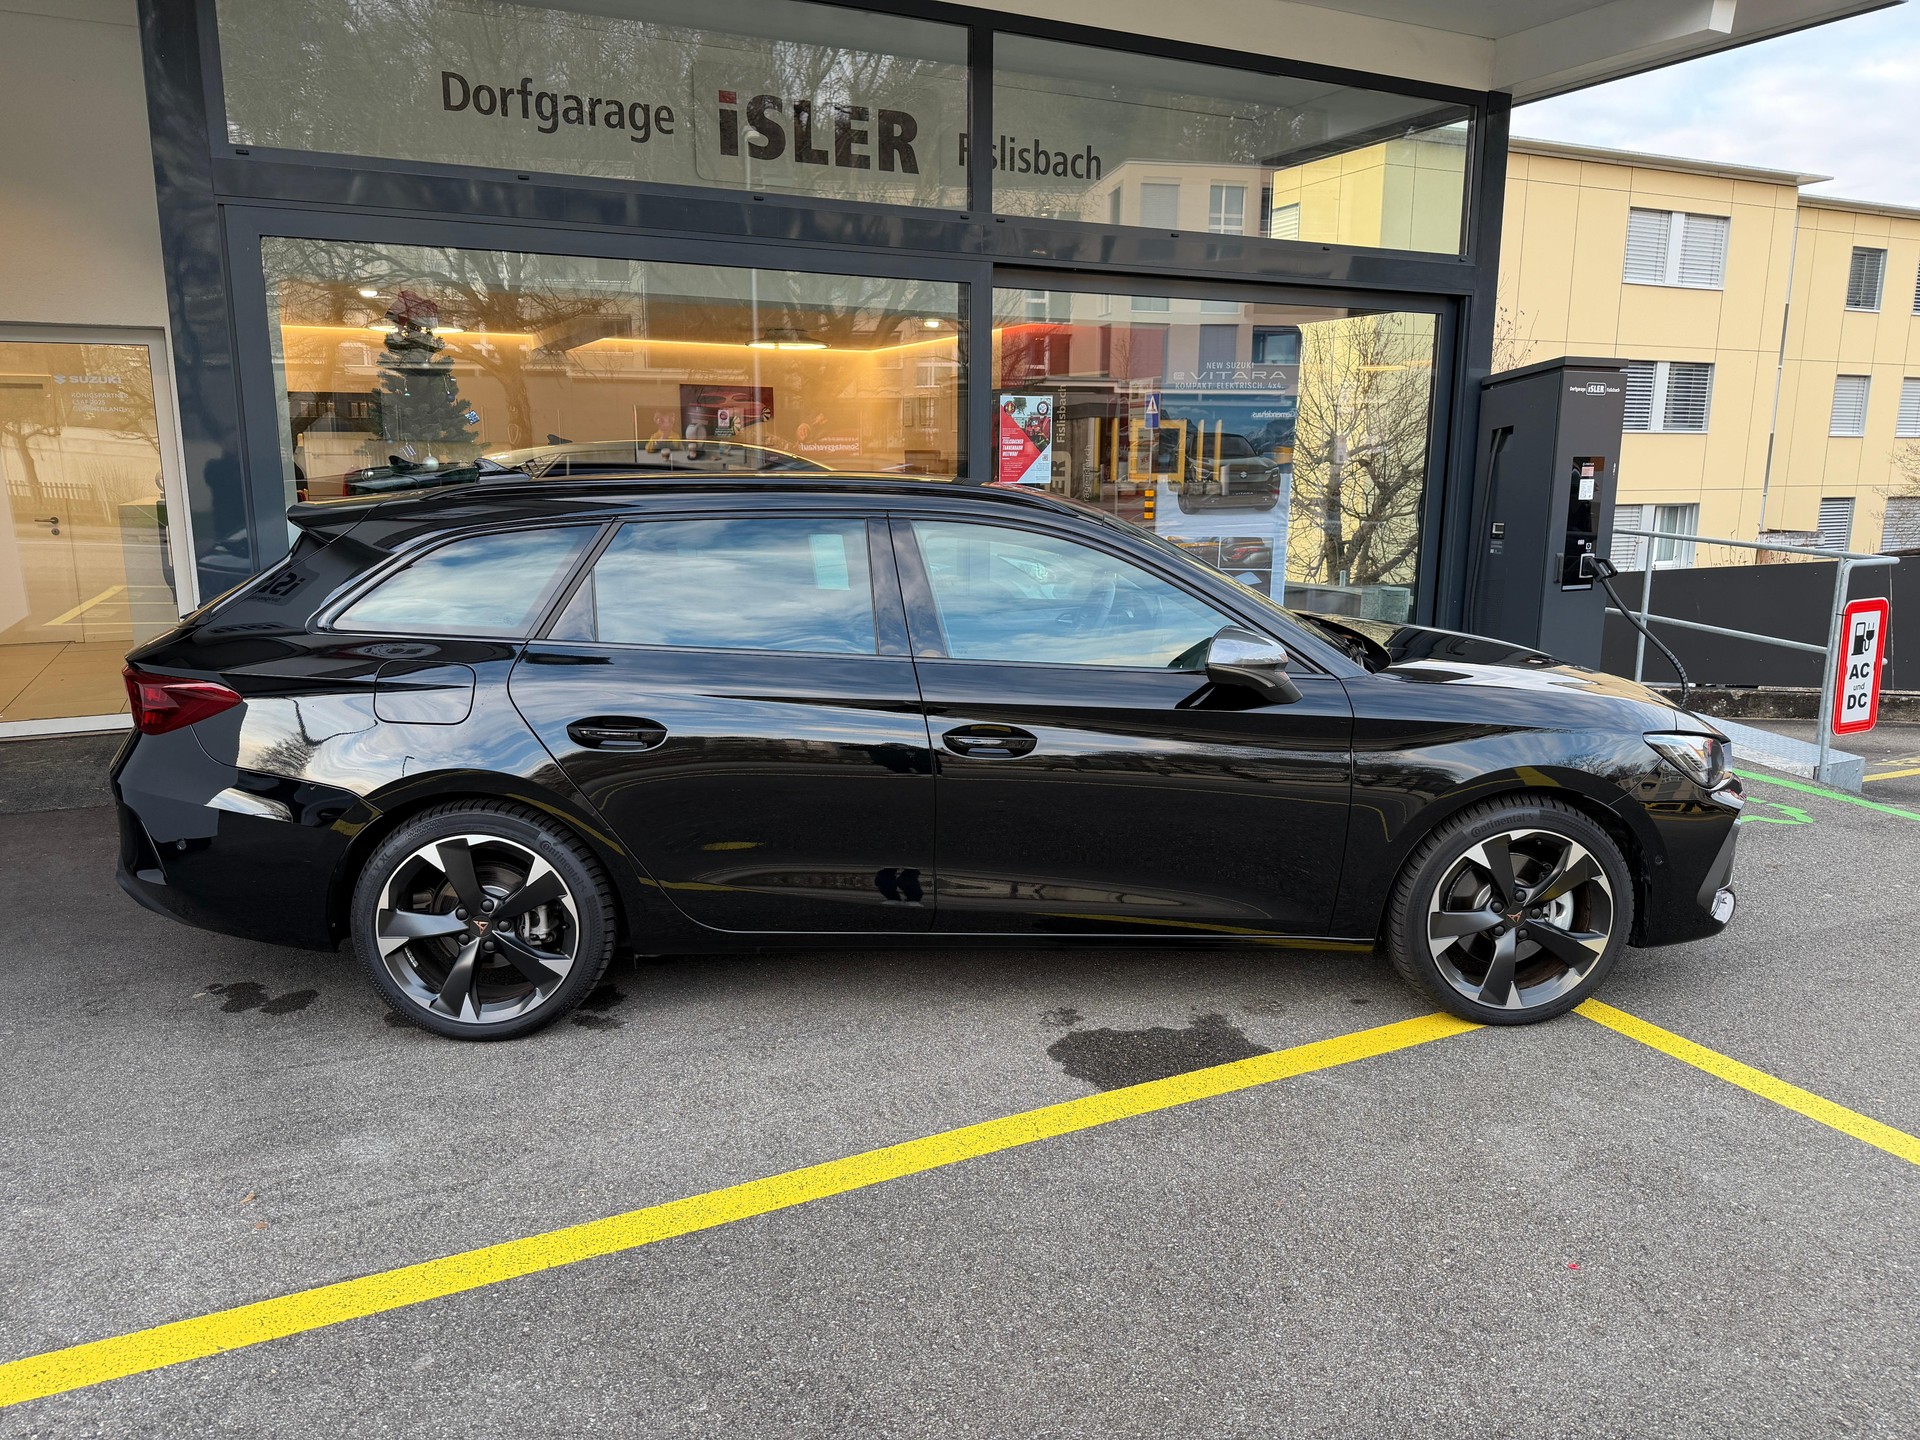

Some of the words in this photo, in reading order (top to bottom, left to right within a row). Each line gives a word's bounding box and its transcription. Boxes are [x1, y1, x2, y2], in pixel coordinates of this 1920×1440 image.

[441, 70, 675, 144] Dorfgarage
[718, 90, 920, 176] iSLER
[69, 376, 122, 384] SUZUKI
[1190, 372, 1286, 380] VITARA
[1056, 384, 1066, 443] Fislisbach
[1849, 662, 1870, 680] AC
[1853, 682, 1865, 691] und
[1847, 692, 1868, 710] DC
[1470, 814, 1525, 838] Continental
[540, 840, 585, 887] Continental
